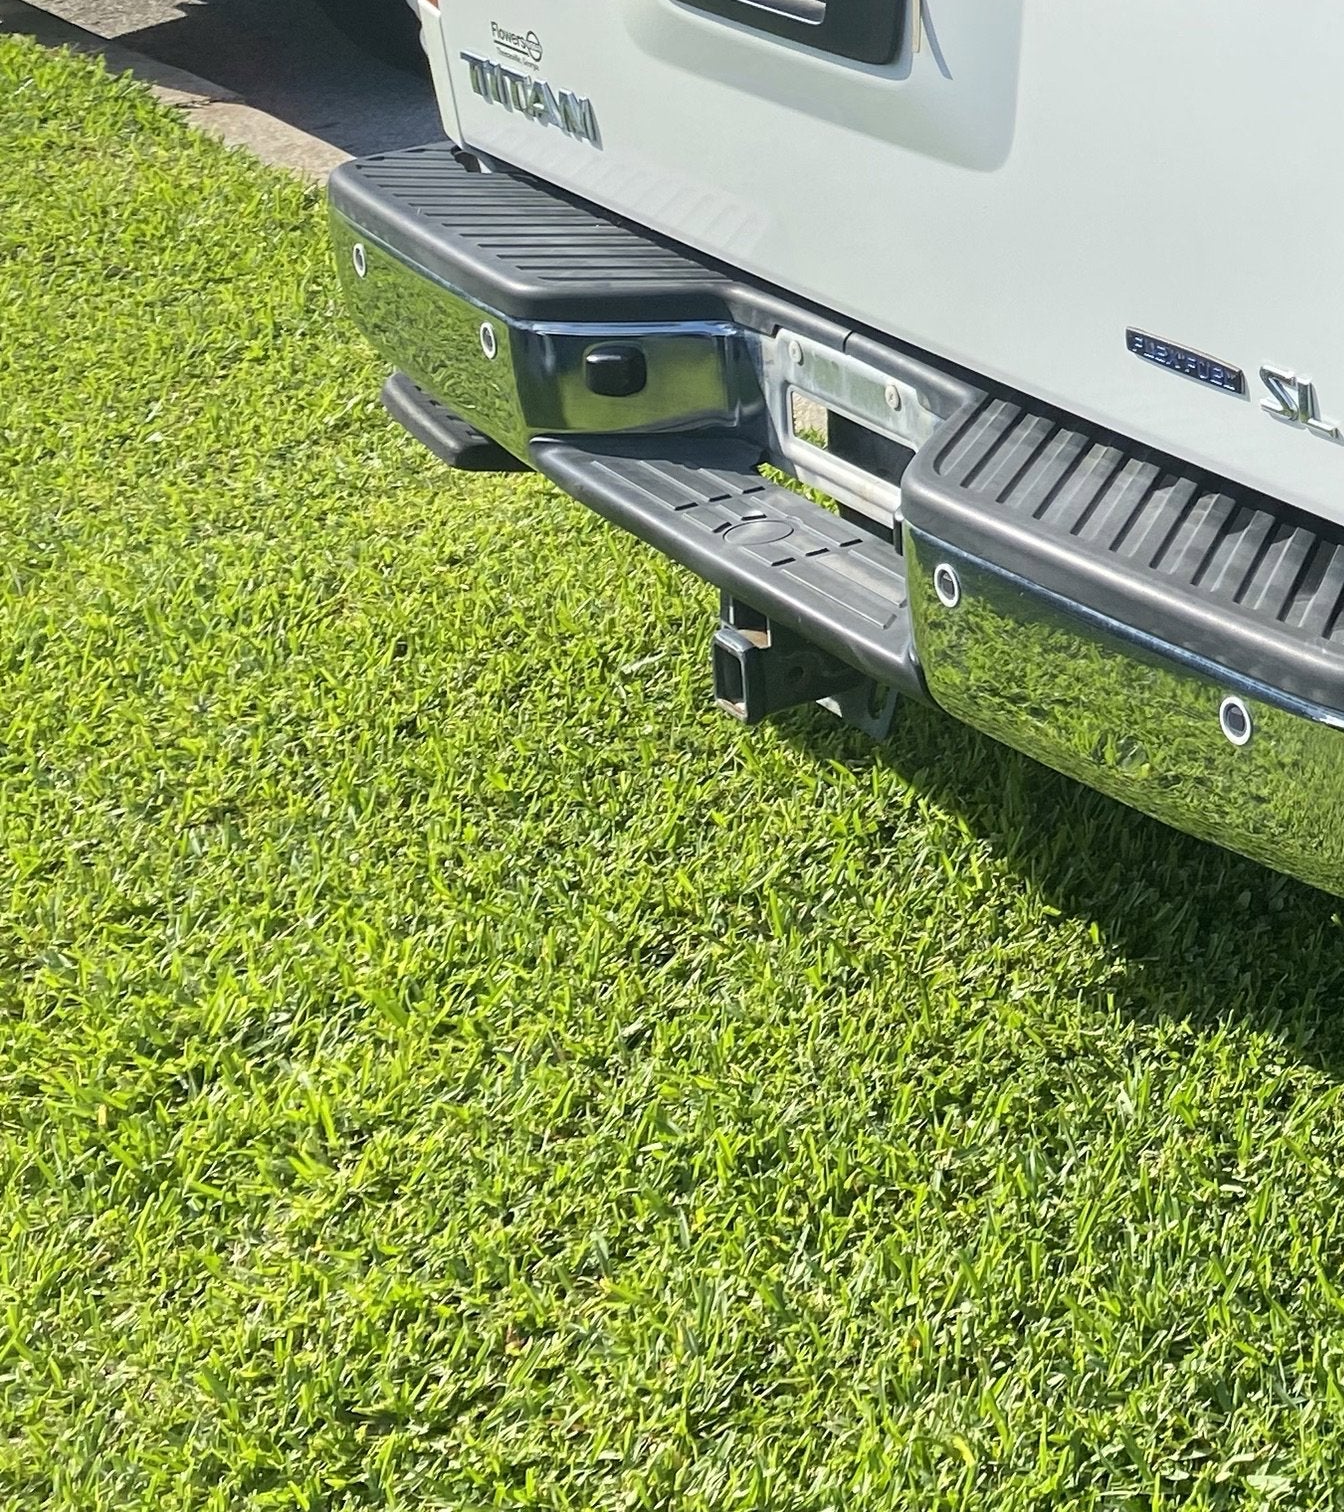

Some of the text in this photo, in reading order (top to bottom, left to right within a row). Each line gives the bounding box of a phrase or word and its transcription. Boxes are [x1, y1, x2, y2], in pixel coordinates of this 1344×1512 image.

[490, 20, 527, 49] Flowers
[459, 50, 603, 150] TITAN
[1258, 363, 1342, 443] SL
